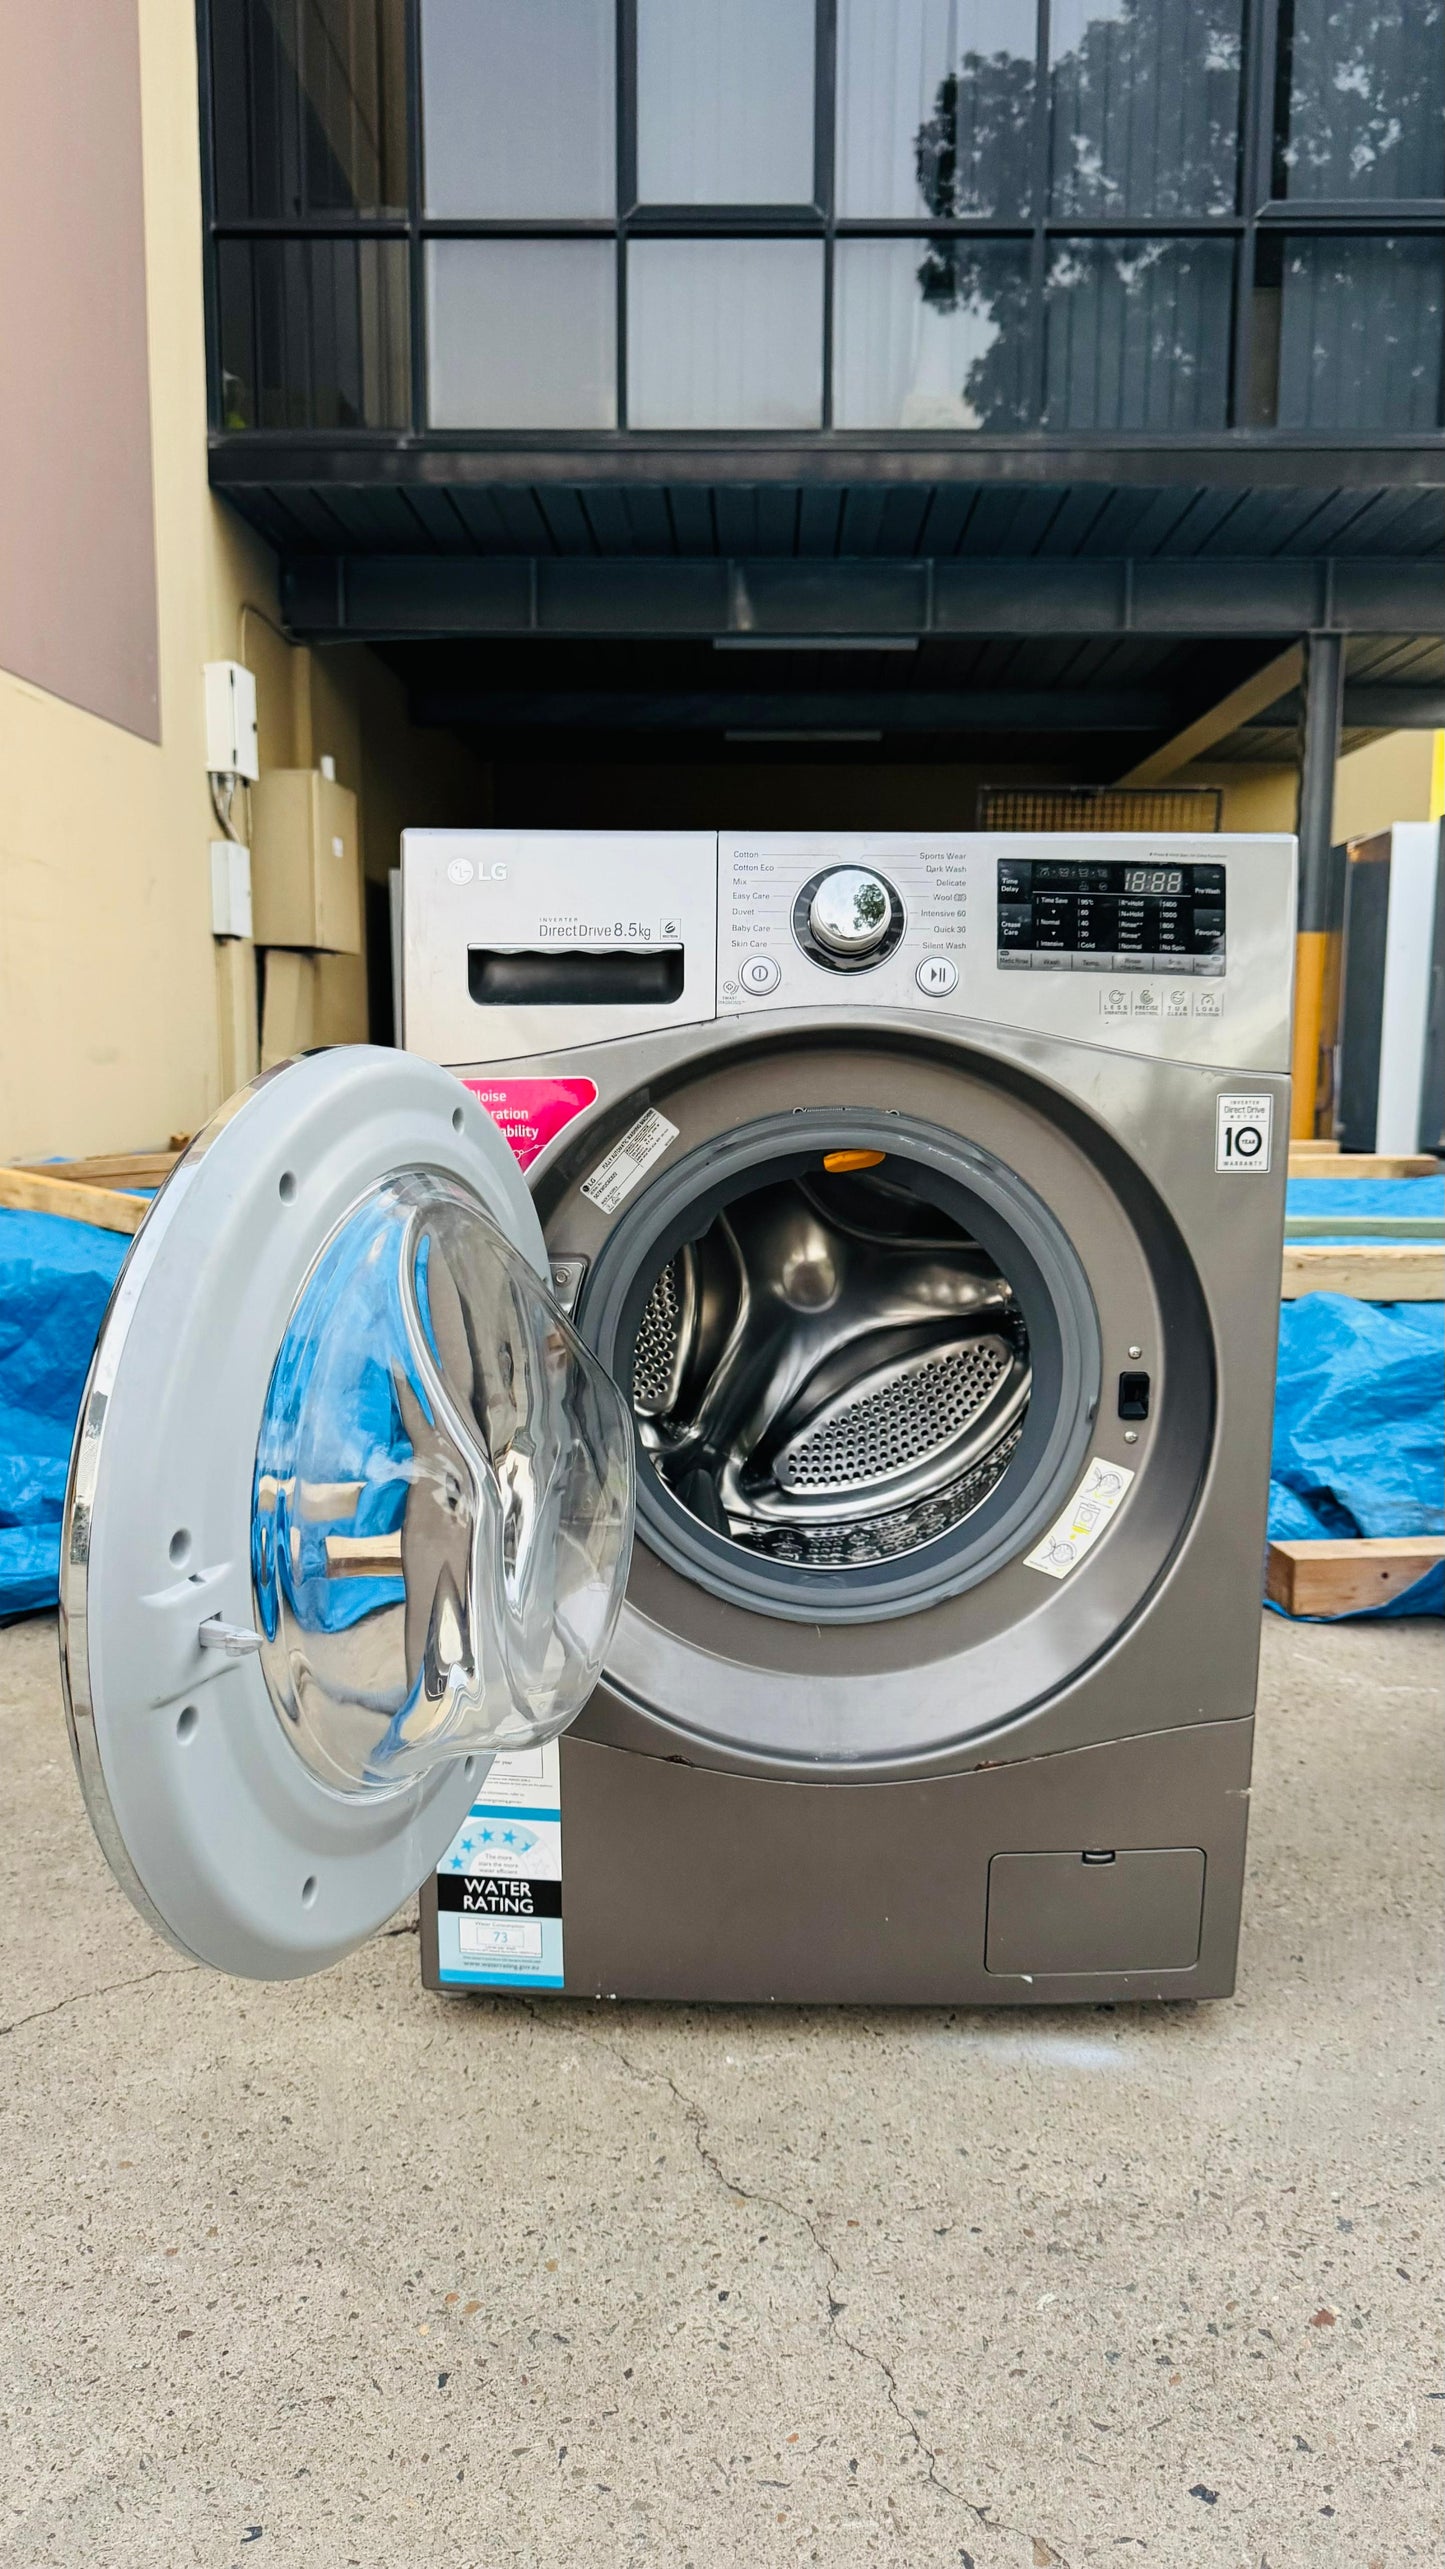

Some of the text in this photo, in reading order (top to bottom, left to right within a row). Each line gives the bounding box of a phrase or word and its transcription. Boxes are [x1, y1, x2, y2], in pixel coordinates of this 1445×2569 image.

[919, 852, 967, 861] Sports Wear
[478, 862, 508, 881] LG
[733, 863, 758, 871] Cotton
[926, 865, 967, 873] Dark Wash
[936, 879, 967, 887] Delicate
[732, 892, 770, 901] Easy Care
[732, 924, 751, 933] Baby
[731, 940, 767, 948] Skin Care
[491, 1107, 529, 1120] ration
[1224, 1106, 1265, 1114] Direct Drive
[500, 1124, 539, 1141] ability
[1225, 1126, 1262, 1157] 10
[464, 1878, 532, 1897] WATER
[463, 1895, 534, 1914] RATING
[493, 1931, 508, 1943] 73
